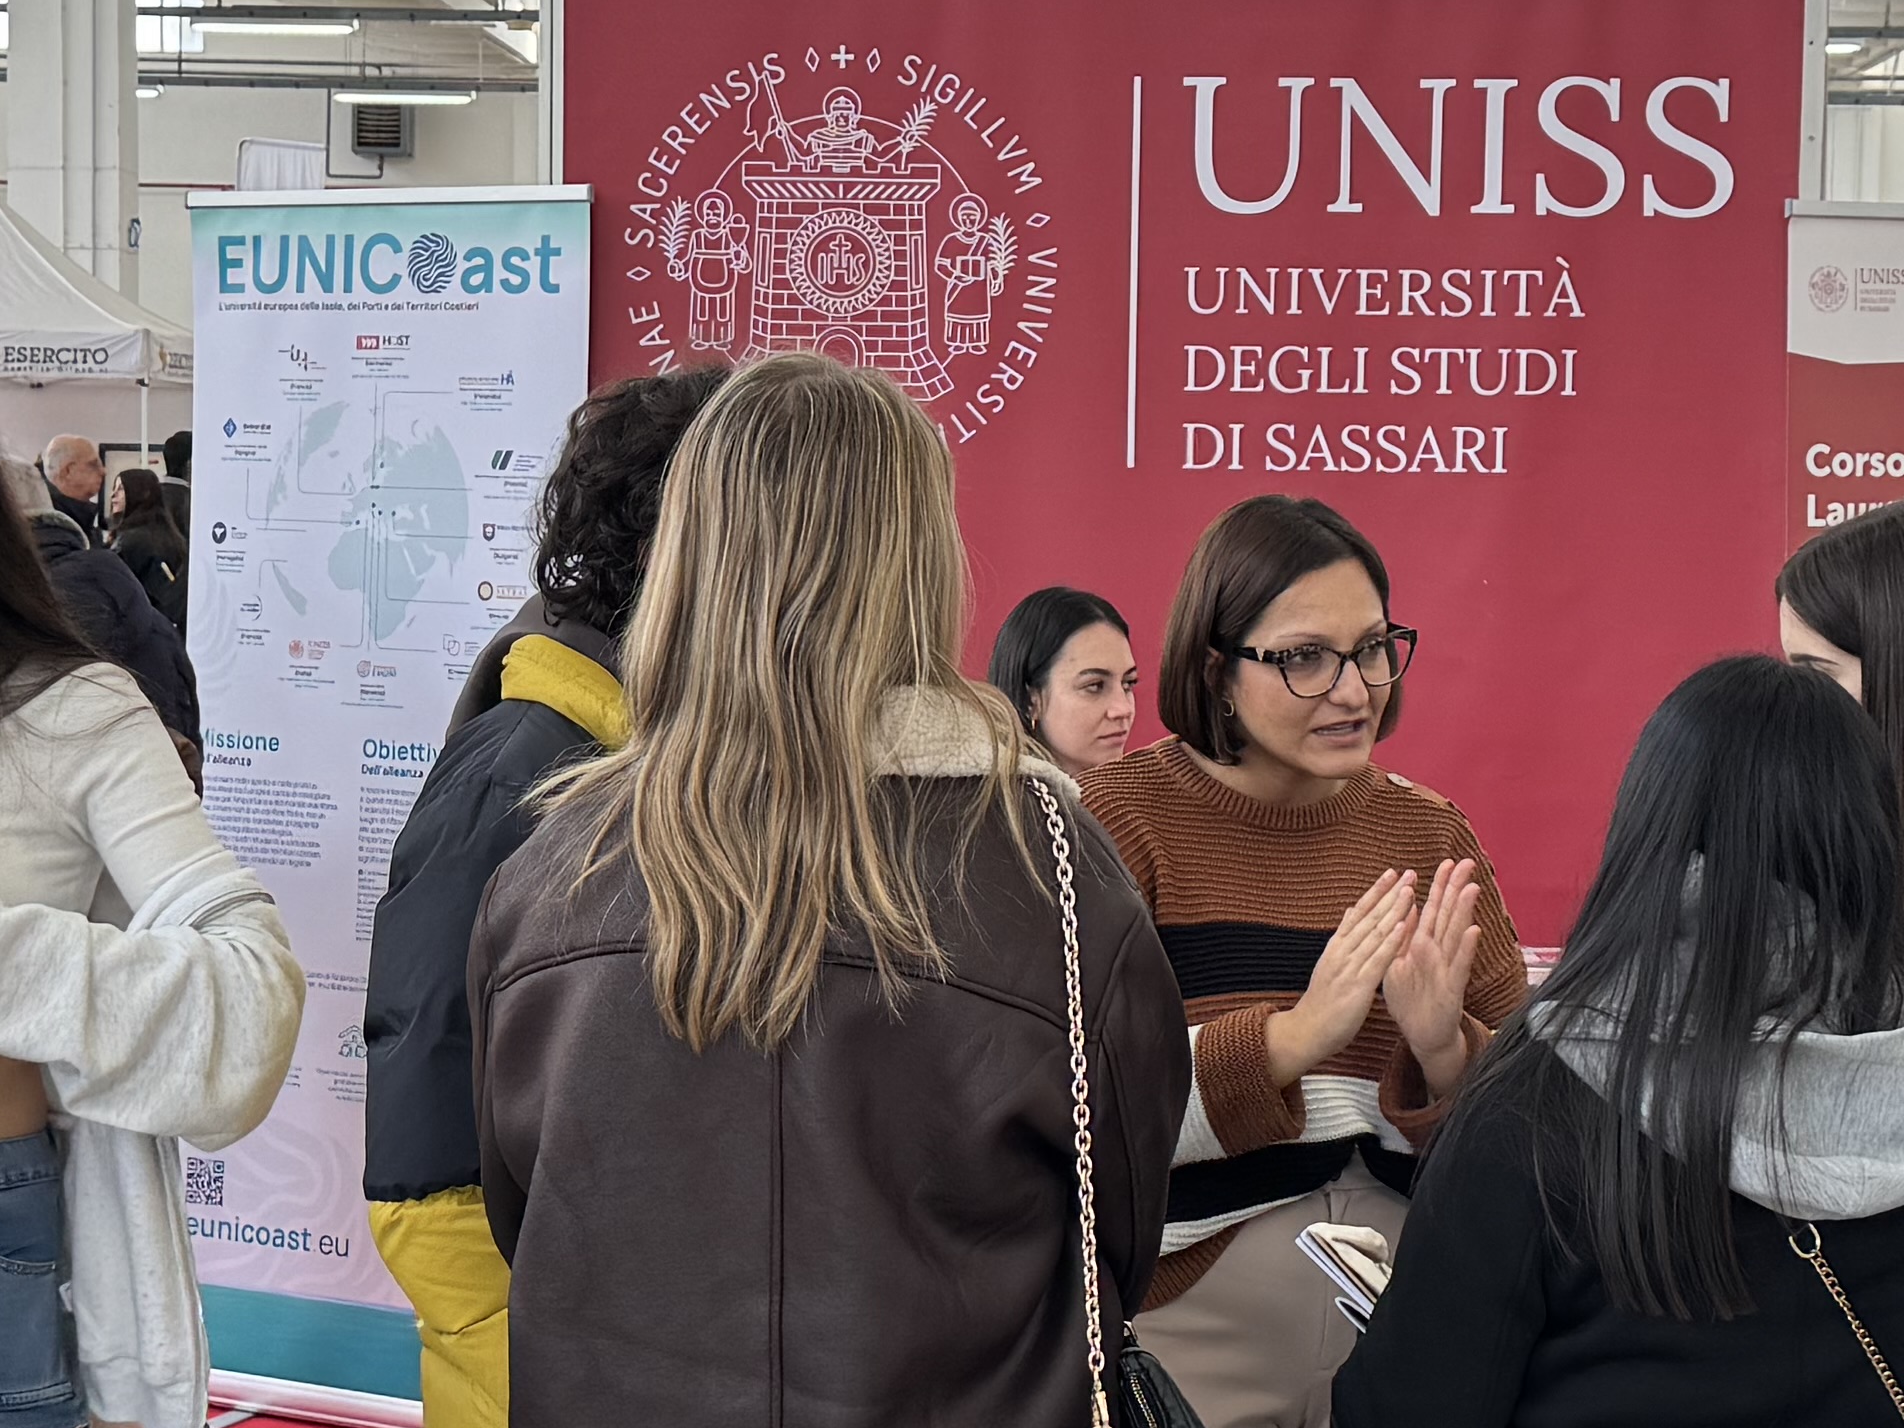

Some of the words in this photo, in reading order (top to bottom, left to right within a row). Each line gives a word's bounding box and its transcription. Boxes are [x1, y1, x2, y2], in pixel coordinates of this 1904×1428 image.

[624, 52, 787, 249] SACERENSIS
[897, 54, 1043, 195] SIGILLVM
[1182, 75, 1735, 219] UNISS
[1183, 255, 1586, 318] UNIVERSITÀ
[3, 346, 109, 365] ESERCITO
[939, 246, 1058, 444] VNIVERSIT
[1183, 345, 1369, 395] DEGLI
[1390, 346, 1578, 397] STUDI
[1182, 423, 1245, 470] DI
[1265, 423, 1508, 475] SASSARI
[362, 738, 437, 762] Obietti
[186, 1215, 350, 1257] eunicoast.eu
